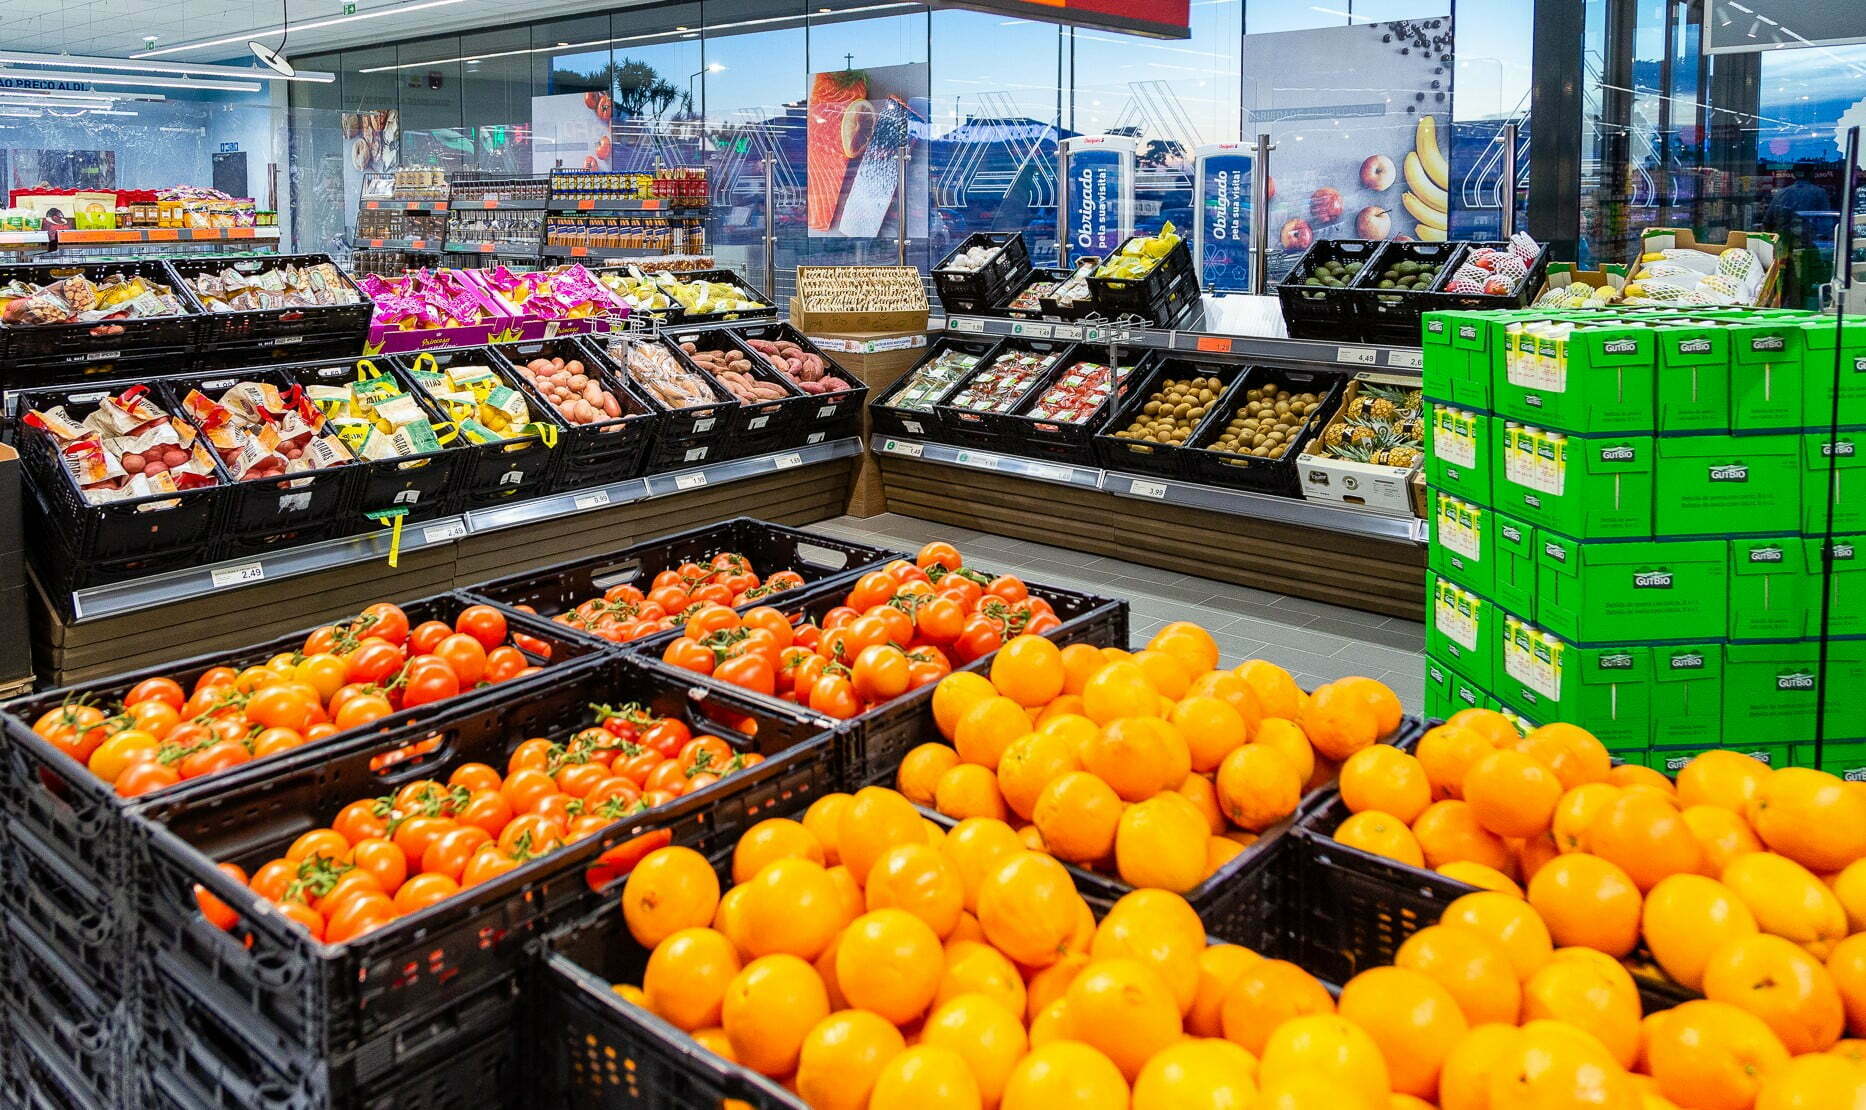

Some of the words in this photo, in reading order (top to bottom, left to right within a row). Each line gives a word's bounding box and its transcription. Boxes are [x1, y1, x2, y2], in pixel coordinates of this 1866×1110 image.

[1098, 168, 1107, 205] visita!
[1231, 171, 1240, 201] visita!
[1078, 168, 1096, 248] Obrigado
[1213, 170, 1230, 240] Obrigado
[1232, 202, 1240, 218] sua
[1099, 206, 1107, 222] sua
[1098, 226, 1107, 248] pela
[1231, 221, 1240, 241] pela
[1605, 343, 1636, 353] GUTBIO
[1680, 343, 1710, 353] GUTBIO
[1603, 451, 1633, 460] GUTBIO
[1711, 470, 1746, 480] GUTBIO
[1635, 576, 1671, 587] GUTBIO
[1778, 678, 1813, 688] GUTBIO
